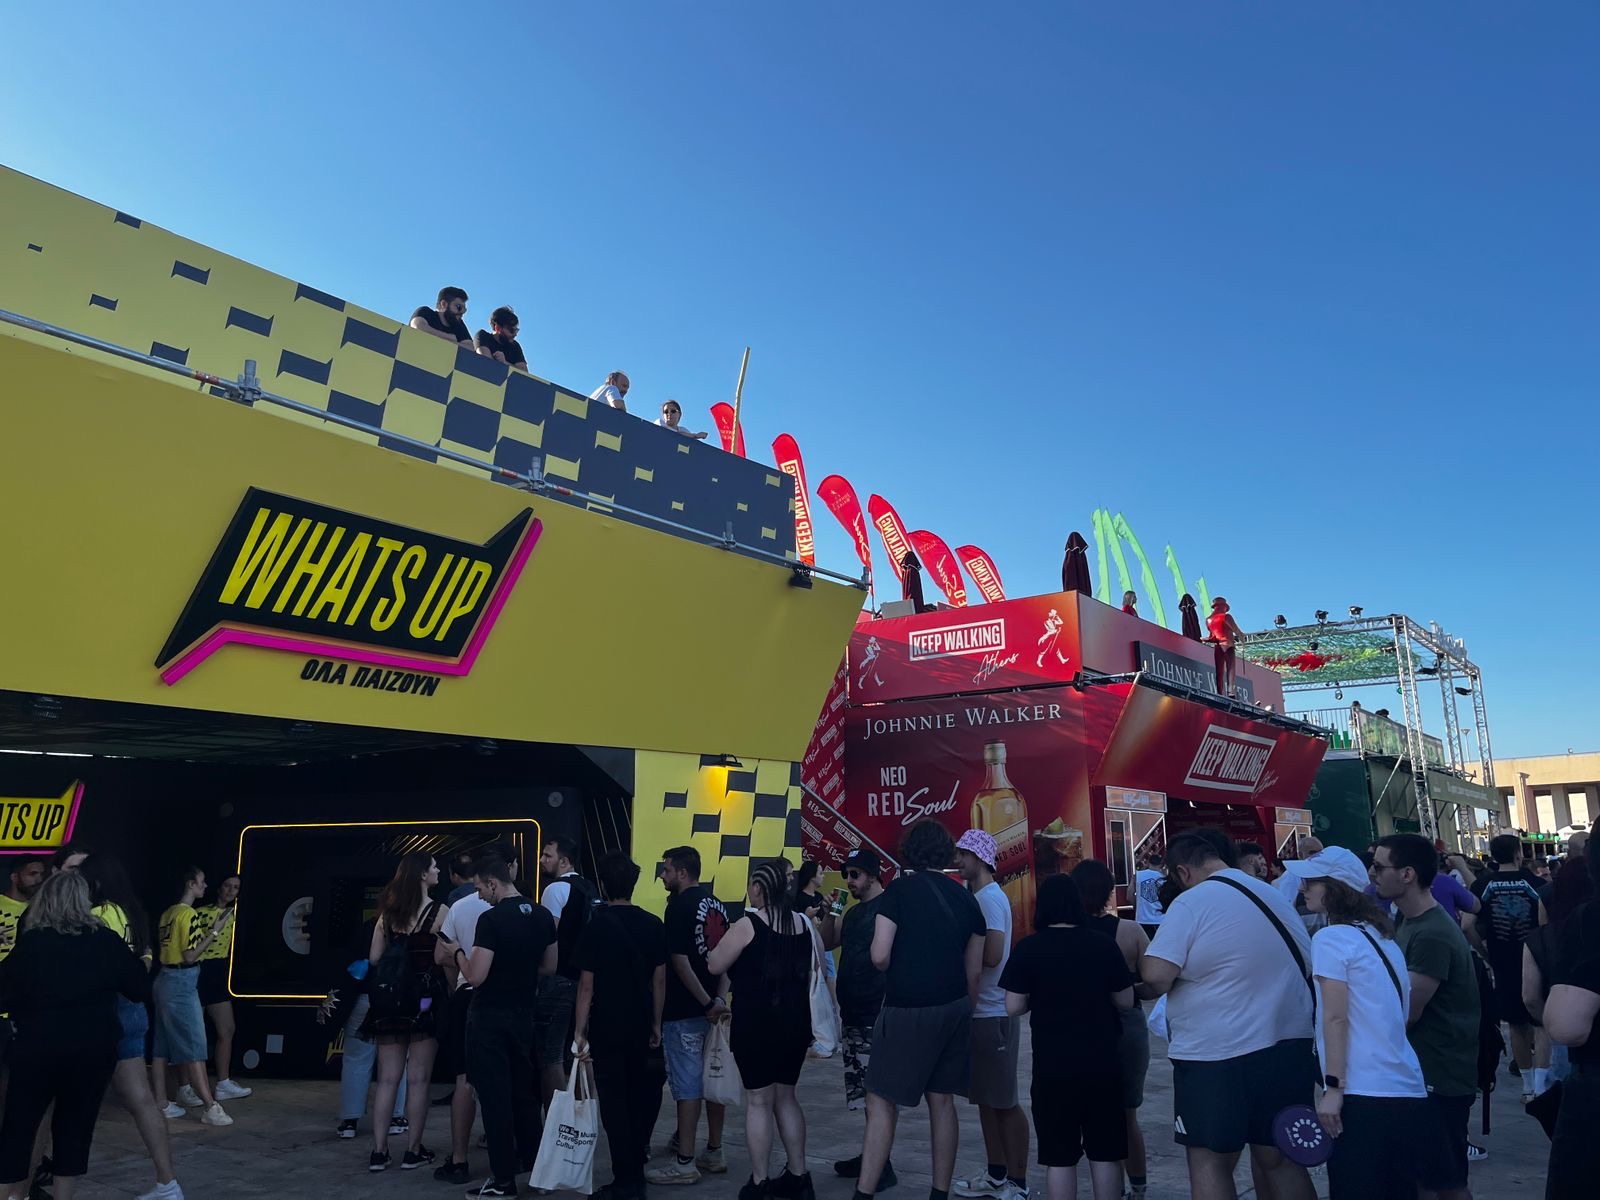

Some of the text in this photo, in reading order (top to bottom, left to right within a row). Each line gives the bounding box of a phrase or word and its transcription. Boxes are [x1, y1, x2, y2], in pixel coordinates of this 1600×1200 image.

[218, 507, 493, 643] WHATS UP
[912, 625, 1001, 656] KEEP WALKING
[973, 650, 1019, 685] Athens
[864, 714, 956, 740] JOHNNIE
[965, 703, 1062, 727] WALKER
[880, 766, 907, 787] NEO
[1192, 737, 1268, 782] KEEP WALKING
[868, 792, 905, 817] RED
[901, 779, 960, 827] Soul
[0, 803, 65, 841] TS UP
[696, 898, 709, 922] HOT
[695, 924, 708, 955] RED
